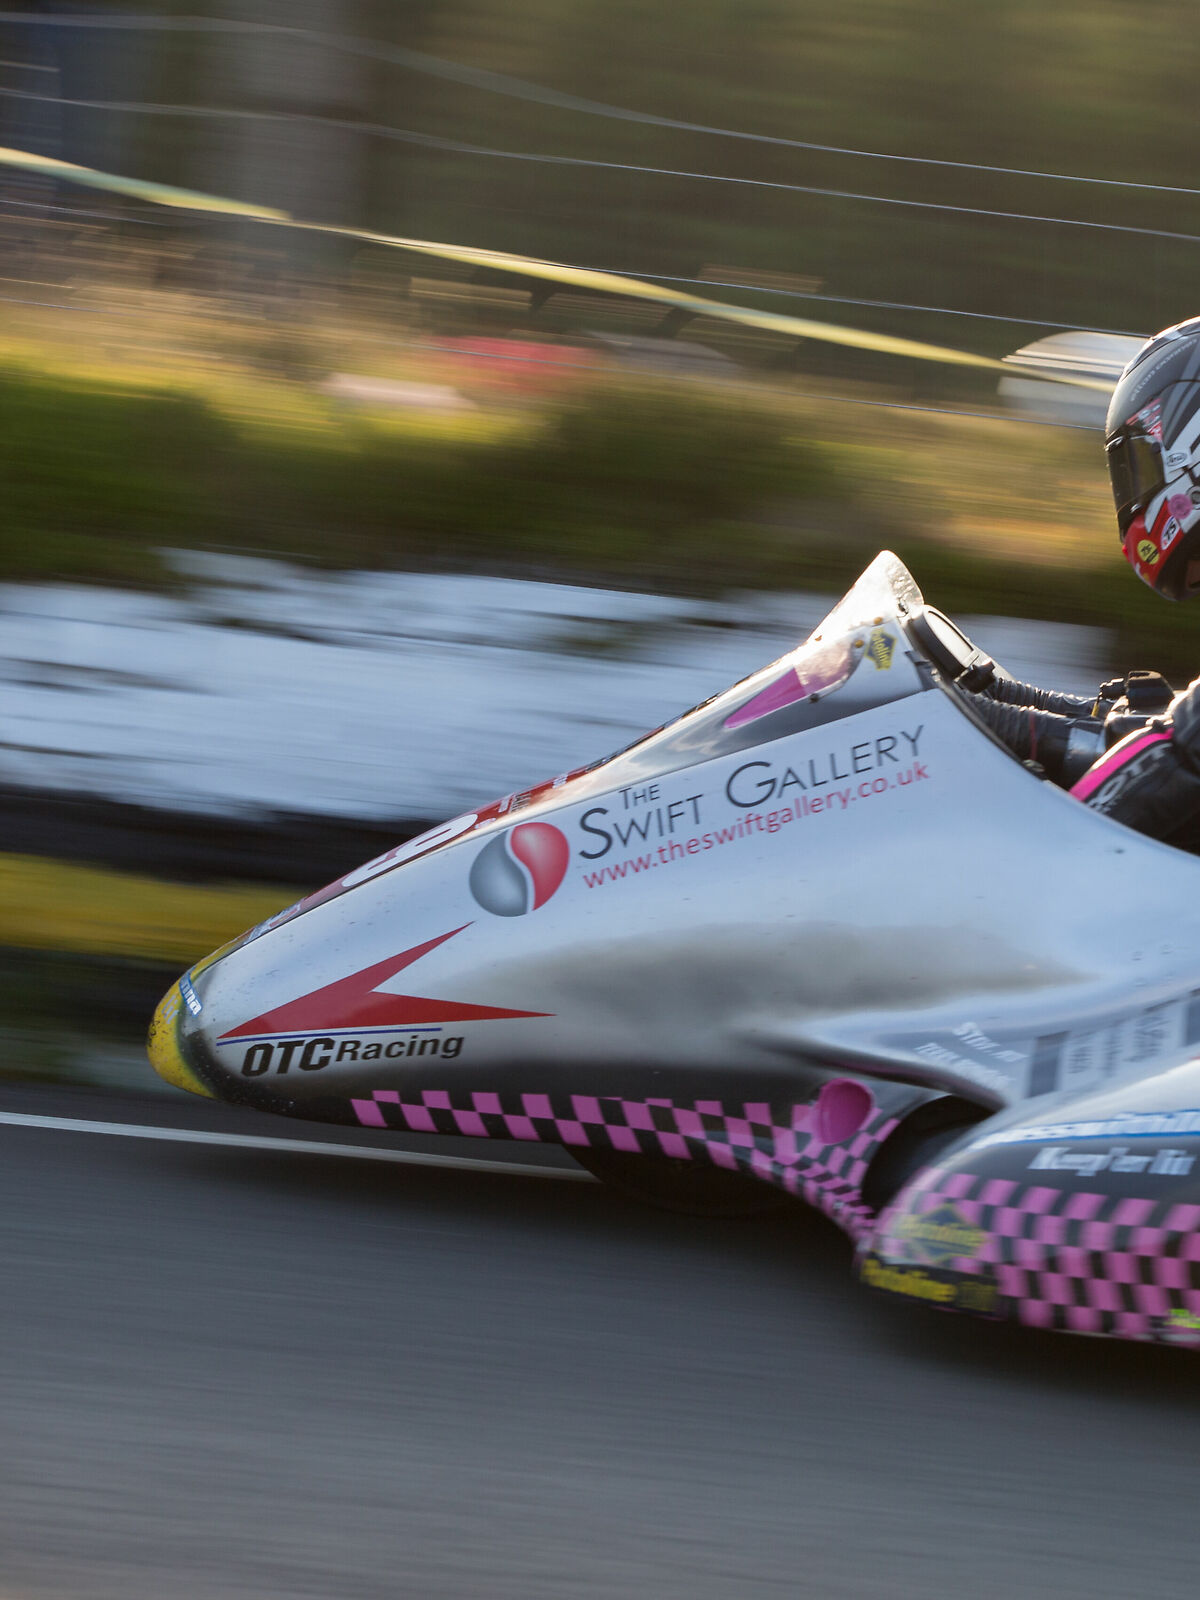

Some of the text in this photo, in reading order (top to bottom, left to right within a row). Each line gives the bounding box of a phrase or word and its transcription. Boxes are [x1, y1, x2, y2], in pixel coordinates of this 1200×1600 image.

[579, 724, 924, 860] SWIFT GALLERY
[583, 761, 931, 889] www.theswiftgallery.co.uk
[618, 784, 661, 810] THE
[241, 1035, 465, 1078] OTC Racing
